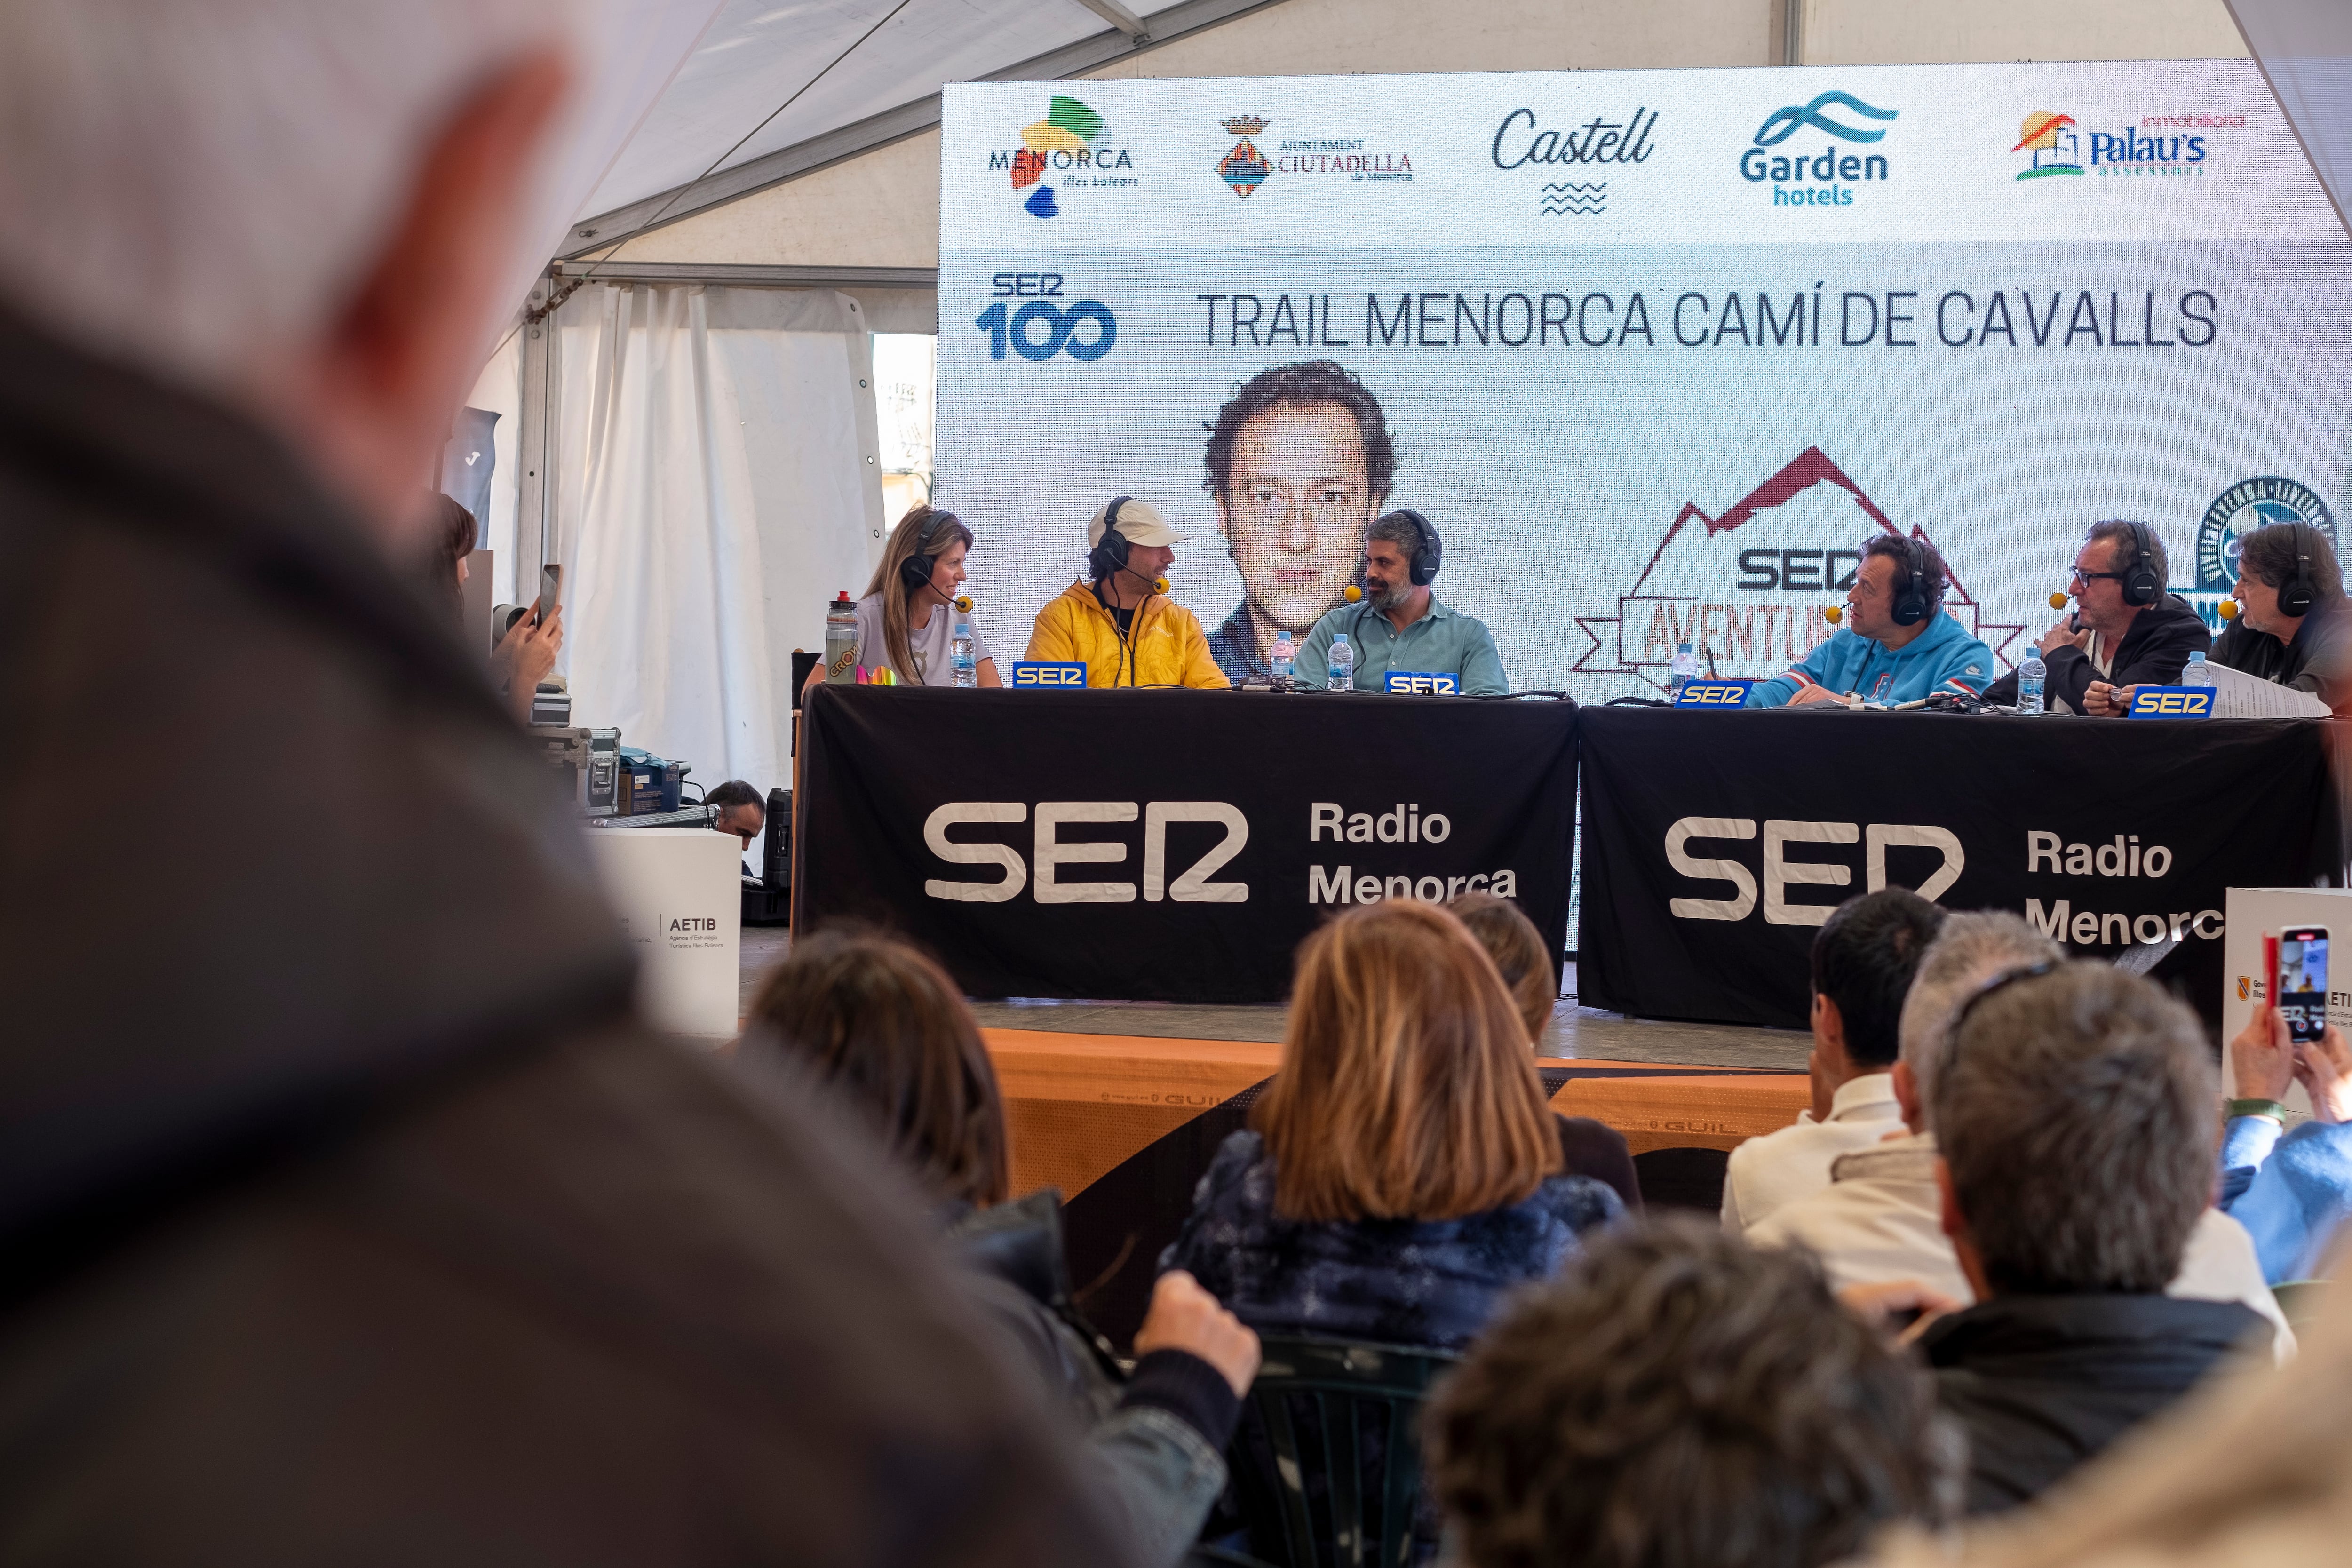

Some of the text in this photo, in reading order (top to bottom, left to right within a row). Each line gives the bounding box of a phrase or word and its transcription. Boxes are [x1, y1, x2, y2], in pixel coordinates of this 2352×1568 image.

[1279, 140, 1364, 151] AJUNTAMENT
[1492, 107, 1659, 170] Castell
[2089, 127, 2205, 165] Palau's
[988, 149, 1133, 170] MENORCA
[1279, 154, 1412, 173] CIUTADELLA
[1740, 146, 1888, 182] Garden
[1062, 175, 1138, 186] illes balears
[1367, 172, 1412, 181] Menorca
[1773, 183, 1853, 206] hotels
[993, 273, 1064, 297] SER
[1197, 281, 2217, 348] TRAIL MENORCA CAMÍ DE CAVALLS
[975, 300, 1117, 361] 100
[1738, 549, 1861, 591] SER
[1016, 667, 1082, 685] SER
[1390, 677, 1455, 694] SER
[1680, 686, 1744, 704] SER
[2134, 693, 2209, 714] SER
[1311, 802, 1451, 843] Radio
[923, 801, 1248, 903] SER
[2027, 830, 2172, 878] Radio
[1665, 816, 1965, 926] SER
[1309, 865, 1517, 905] Menorca
[669, 918, 716, 931] AETIB
[2026, 898, 2225, 945] Menorc
[1664, 1121, 1738, 1134] GUIL
